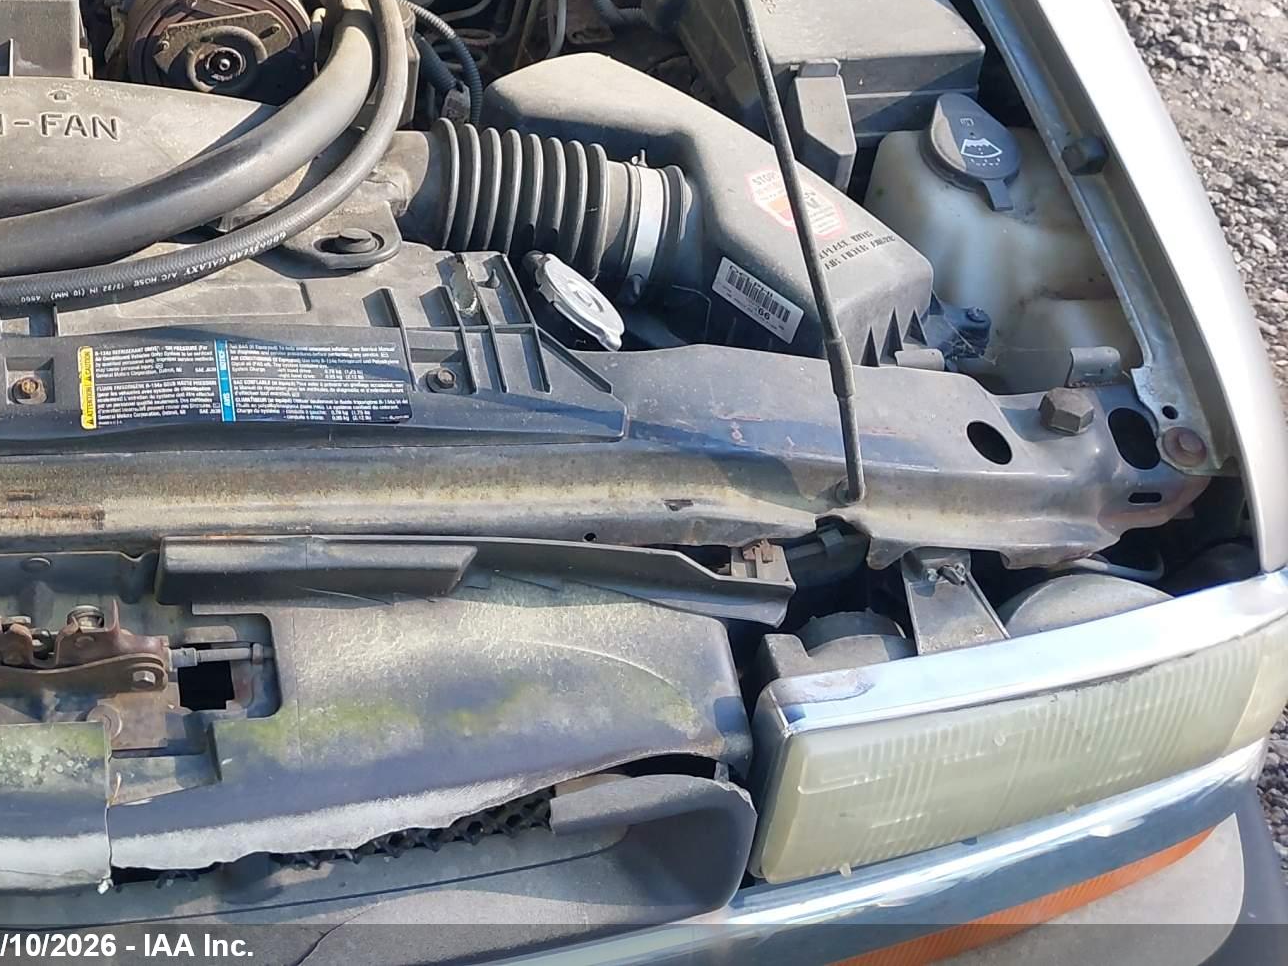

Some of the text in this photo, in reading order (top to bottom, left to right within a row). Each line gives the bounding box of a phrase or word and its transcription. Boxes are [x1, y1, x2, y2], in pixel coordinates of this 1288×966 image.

[184, 257, 227, 276] GALAXY
[133, 274, 157, 287] HOSE
[161, 271, 177, 281] A/C
